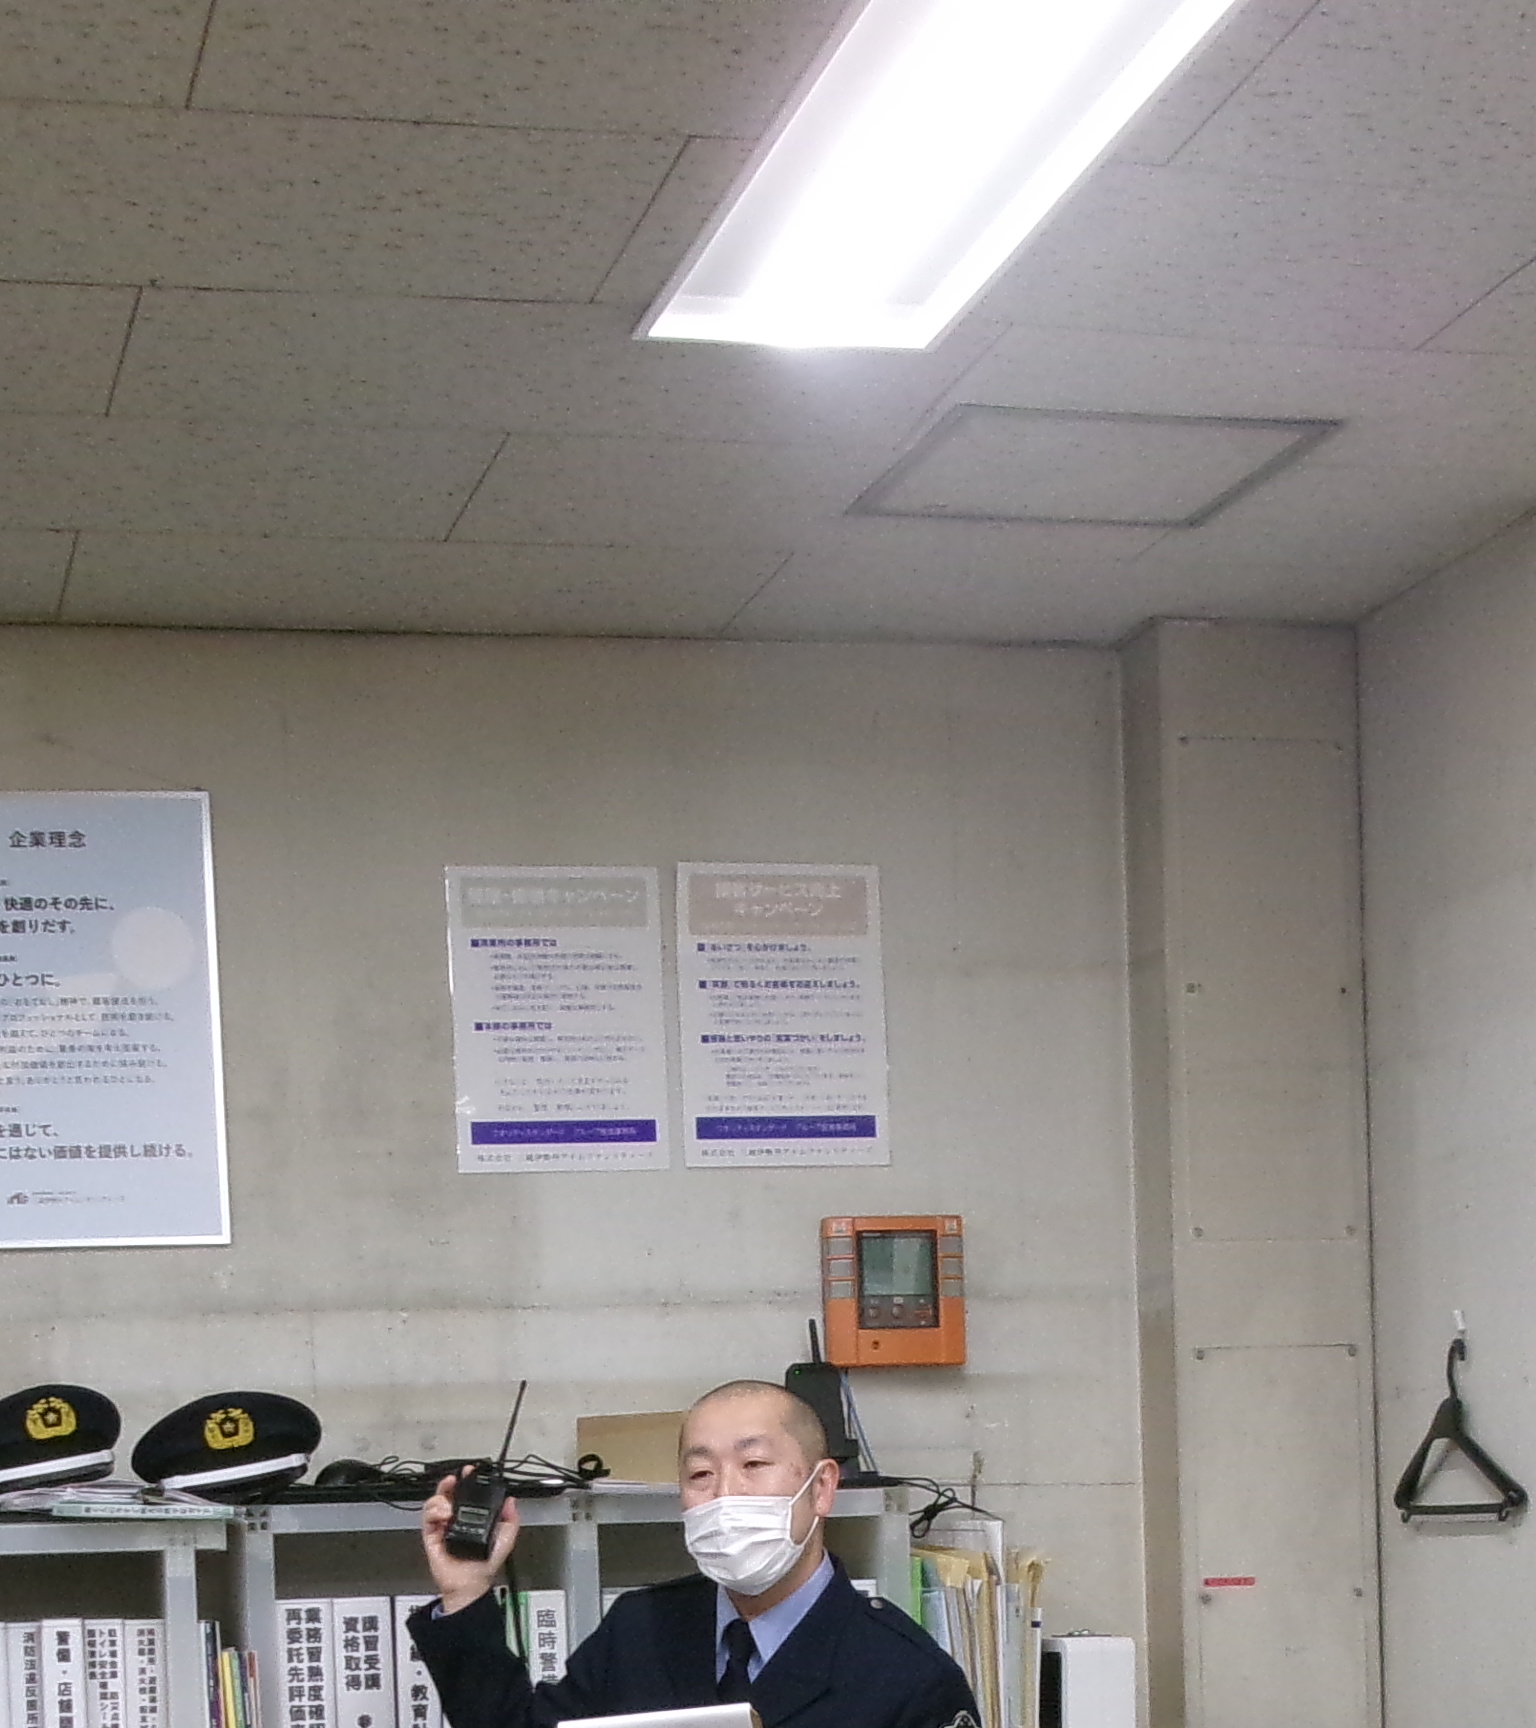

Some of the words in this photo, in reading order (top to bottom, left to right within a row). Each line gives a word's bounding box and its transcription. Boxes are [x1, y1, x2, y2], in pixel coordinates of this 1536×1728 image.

[8, 830, 87, 849] 企業理念
[342, 1616, 362, 1691] 資格取得
